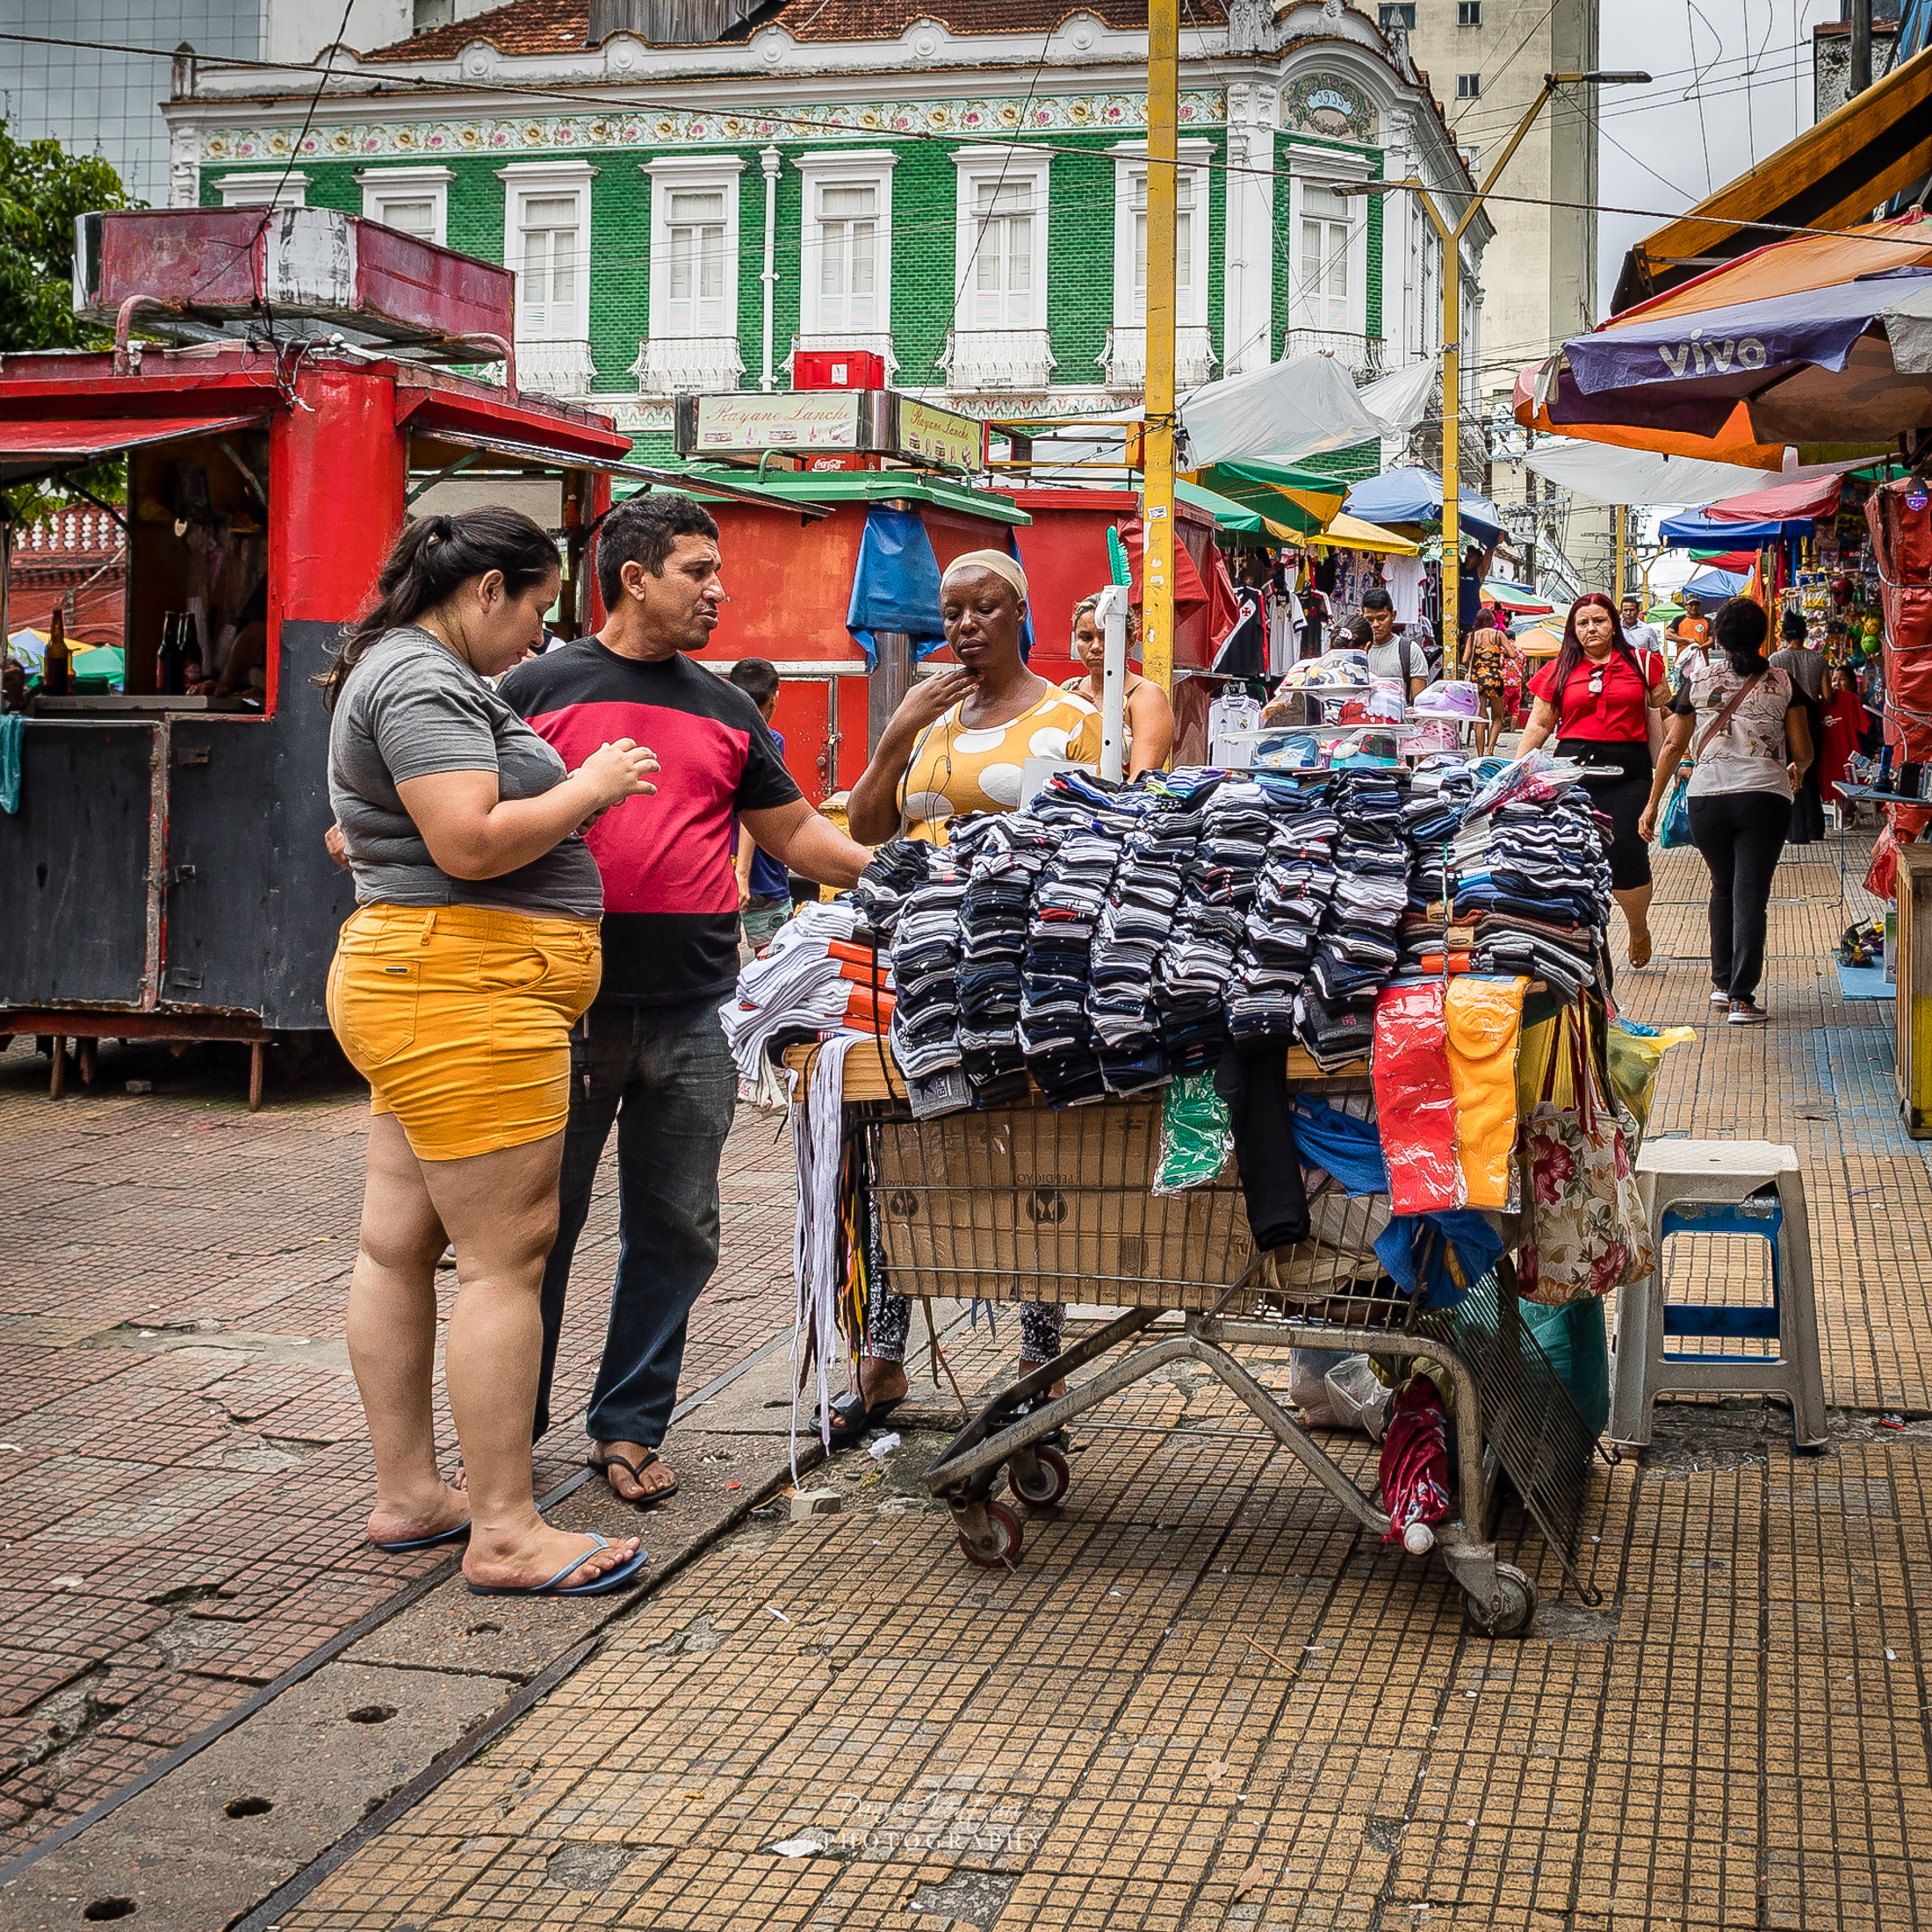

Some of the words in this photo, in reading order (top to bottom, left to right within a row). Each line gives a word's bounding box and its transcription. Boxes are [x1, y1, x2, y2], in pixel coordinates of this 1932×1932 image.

[1658, 328, 1767, 378] vivo
[705, 399, 782, 429] Rayane
[783, 398, 853, 422] Lanche
[910, 404, 942, 435] Rayane
